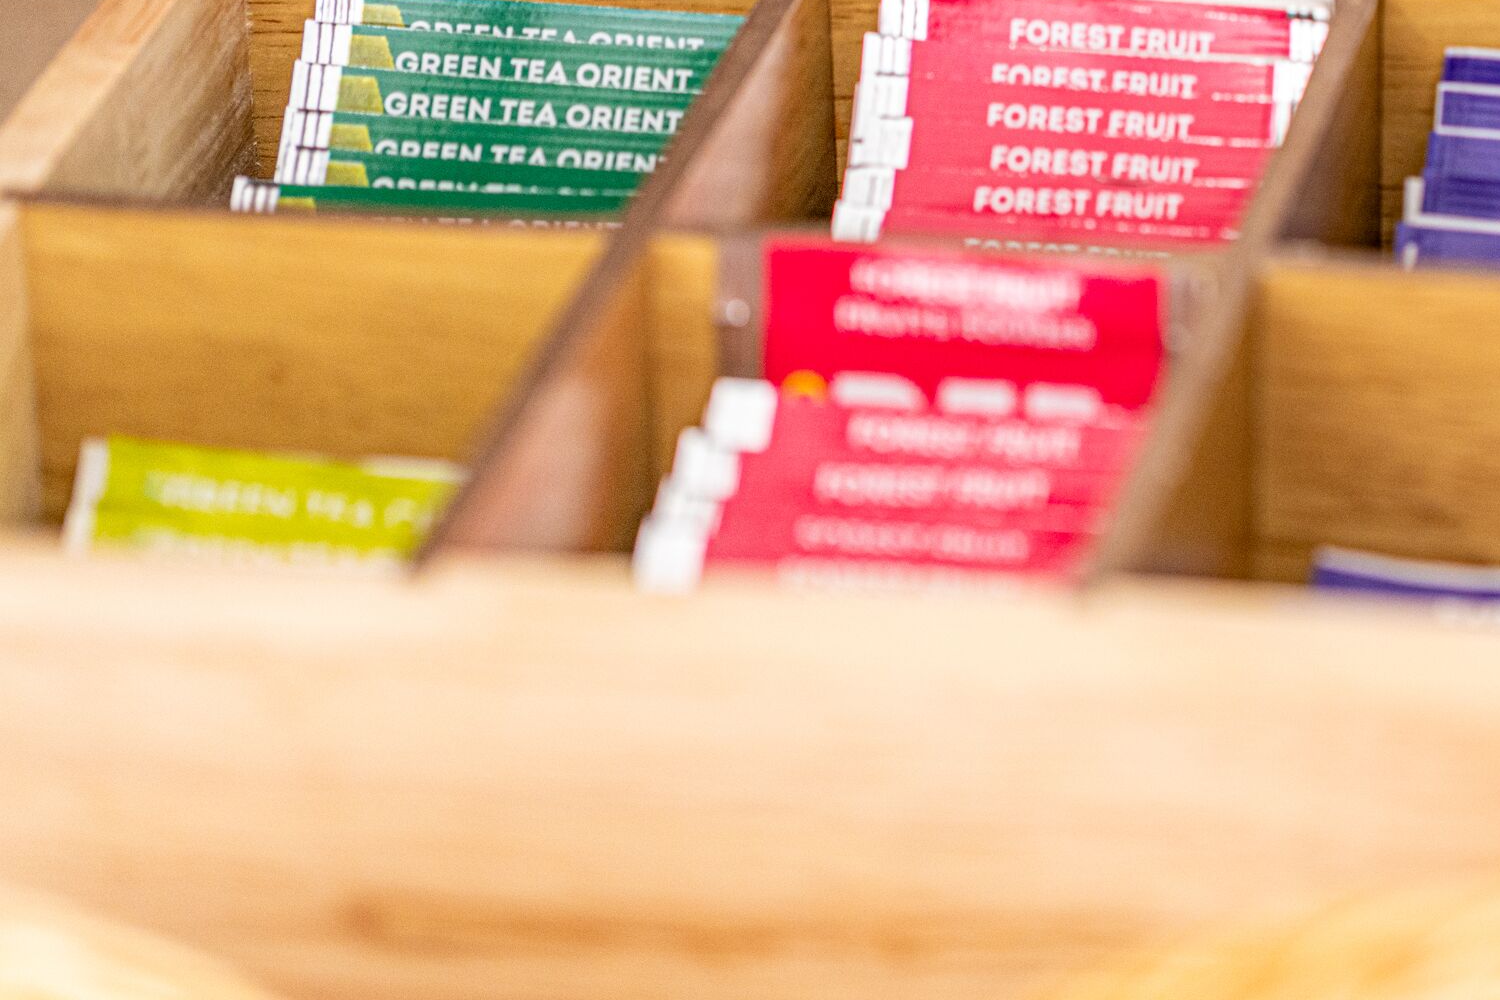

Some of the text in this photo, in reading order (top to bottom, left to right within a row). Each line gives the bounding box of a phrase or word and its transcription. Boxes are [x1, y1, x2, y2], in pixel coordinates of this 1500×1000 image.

[1009, 17, 1215, 55] FOREST FRUIT
[395, 51, 694, 92] GREEN TEA ORIENT
[384, 92, 685, 134] GREEN TEA ORIENT
[987, 102, 1195, 140] FOREST FRUIT
[557, 149, 667, 174] ORIEN
[990, 144, 1199, 185] FOREST FRUIT
[973, 185, 1184, 221] FOREST FRUIT
